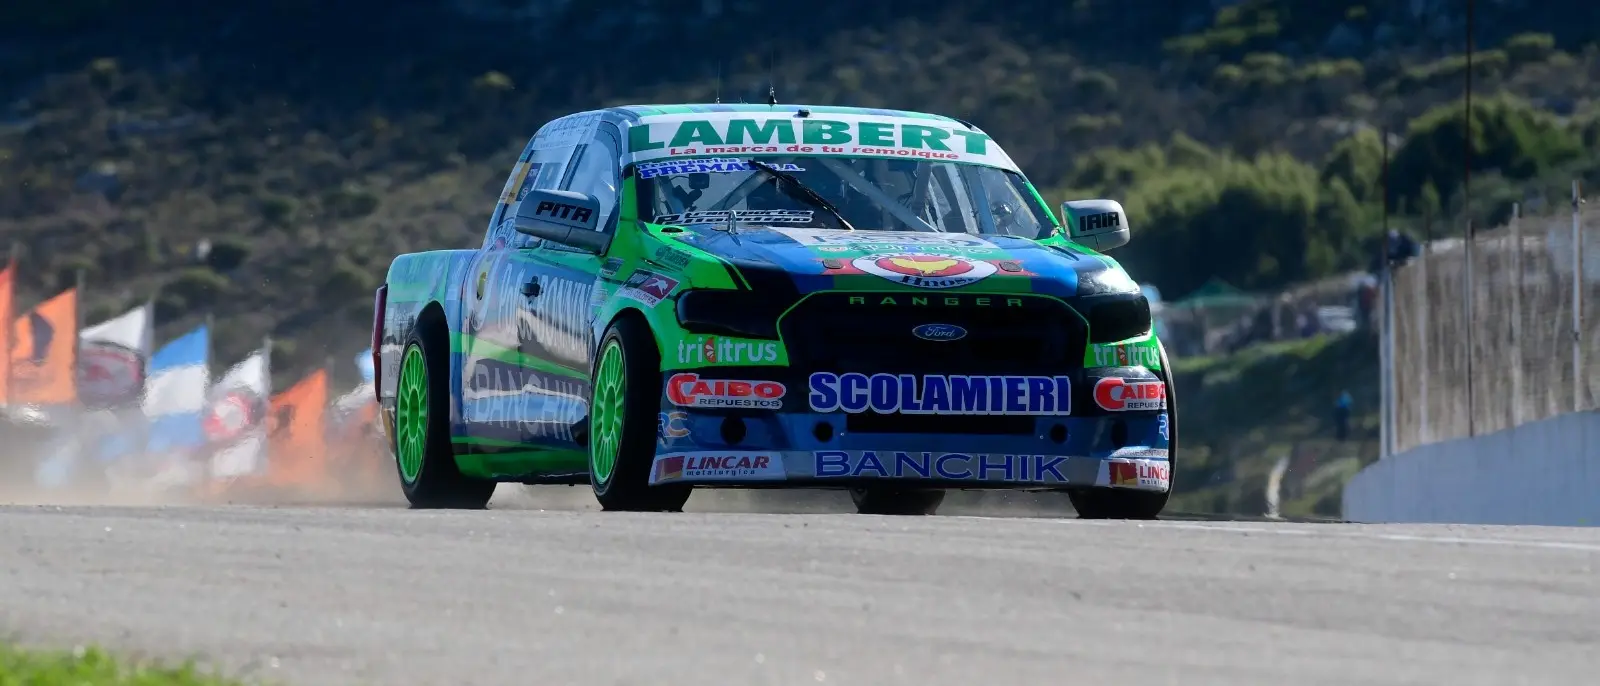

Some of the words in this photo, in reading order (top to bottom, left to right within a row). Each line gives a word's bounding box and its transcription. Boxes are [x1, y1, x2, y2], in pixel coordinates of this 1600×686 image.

[628, 118, 991, 156] LAMBERT
[670, 147, 688, 155] La
[692, 145, 778, 153] marca
[788, 144, 814, 153] de
[820, 144, 844, 153] tu
[847, 146, 960, 160] remolque
[536, 201, 592, 223] PITA
[850, 296, 1023, 307] RANGER
[924, 325, 956, 338] Ford
[666, 373, 786, 405] CAIBO
[808, 371, 1071, 414] SCOLAMIERI
[699, 399, 780, 407] REPUESTOS
[686, 456, 770, 469] LINCAR
[814, 451, 1069, 482] BANCHIK
